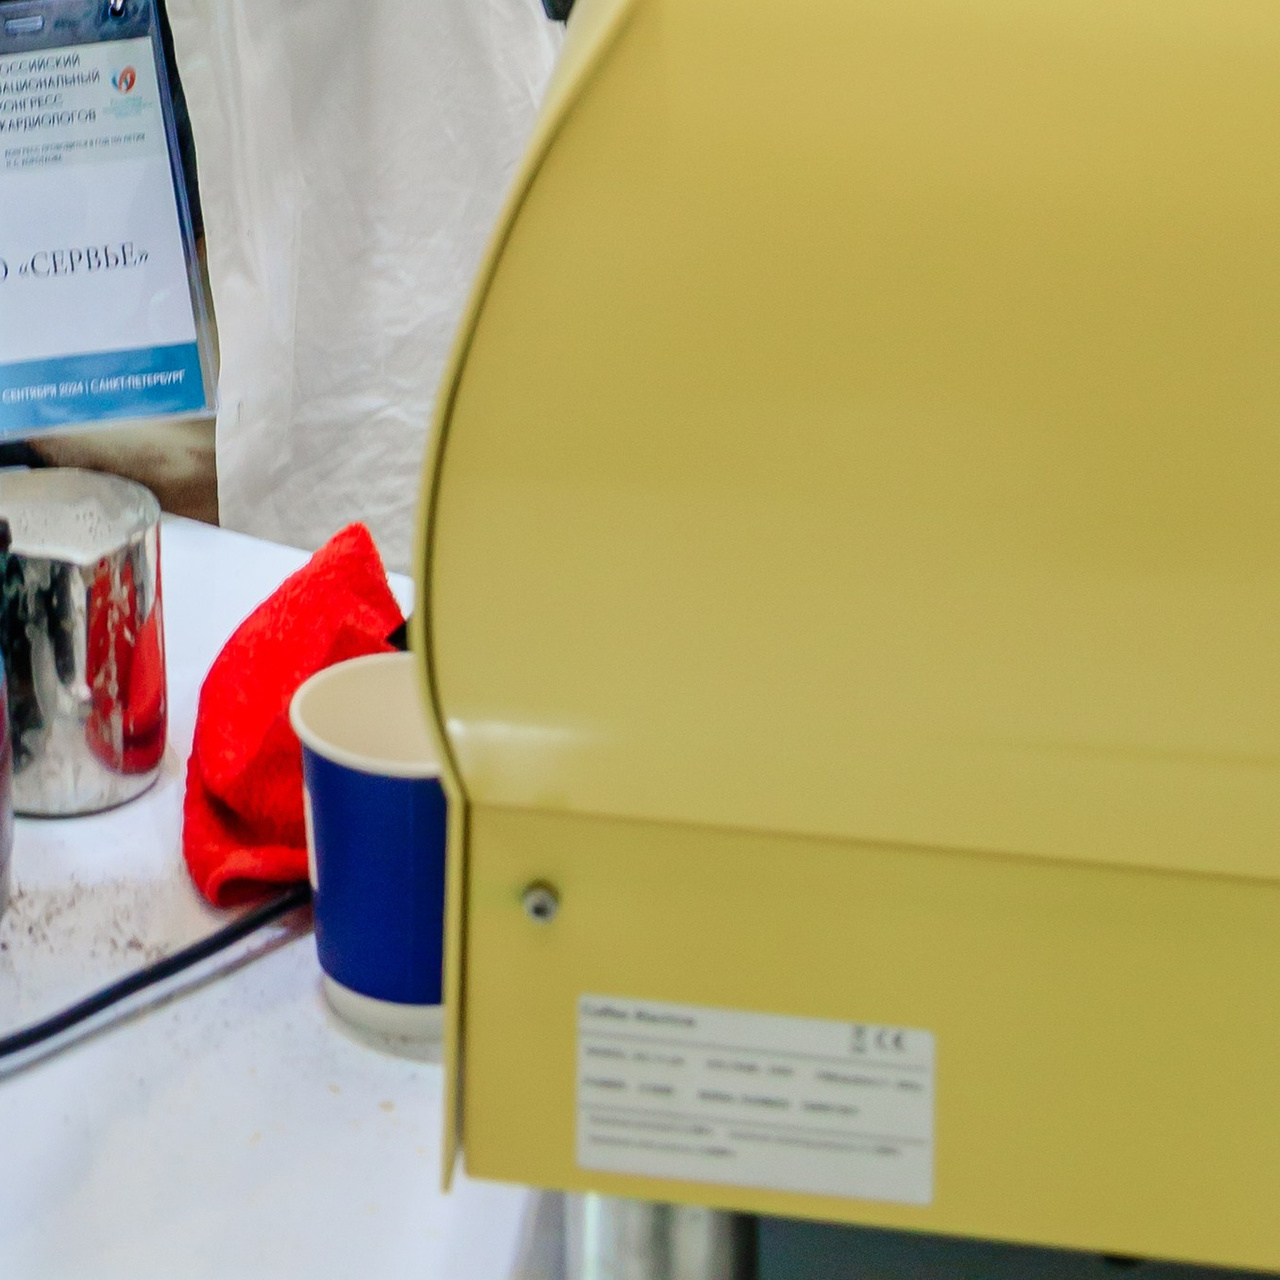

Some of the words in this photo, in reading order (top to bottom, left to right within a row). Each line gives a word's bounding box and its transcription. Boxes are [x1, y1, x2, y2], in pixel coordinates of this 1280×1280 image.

[0, 108, 97, 133] КАРДИОЛОГОВ
[19, 242, 149, 279] «СЕРВЬЕ»
[2, 384, 56, 403] СЕНТЯБРЯ
[91, 369, 186, 395] САНКТ-ПЕТЕРБУРГ
